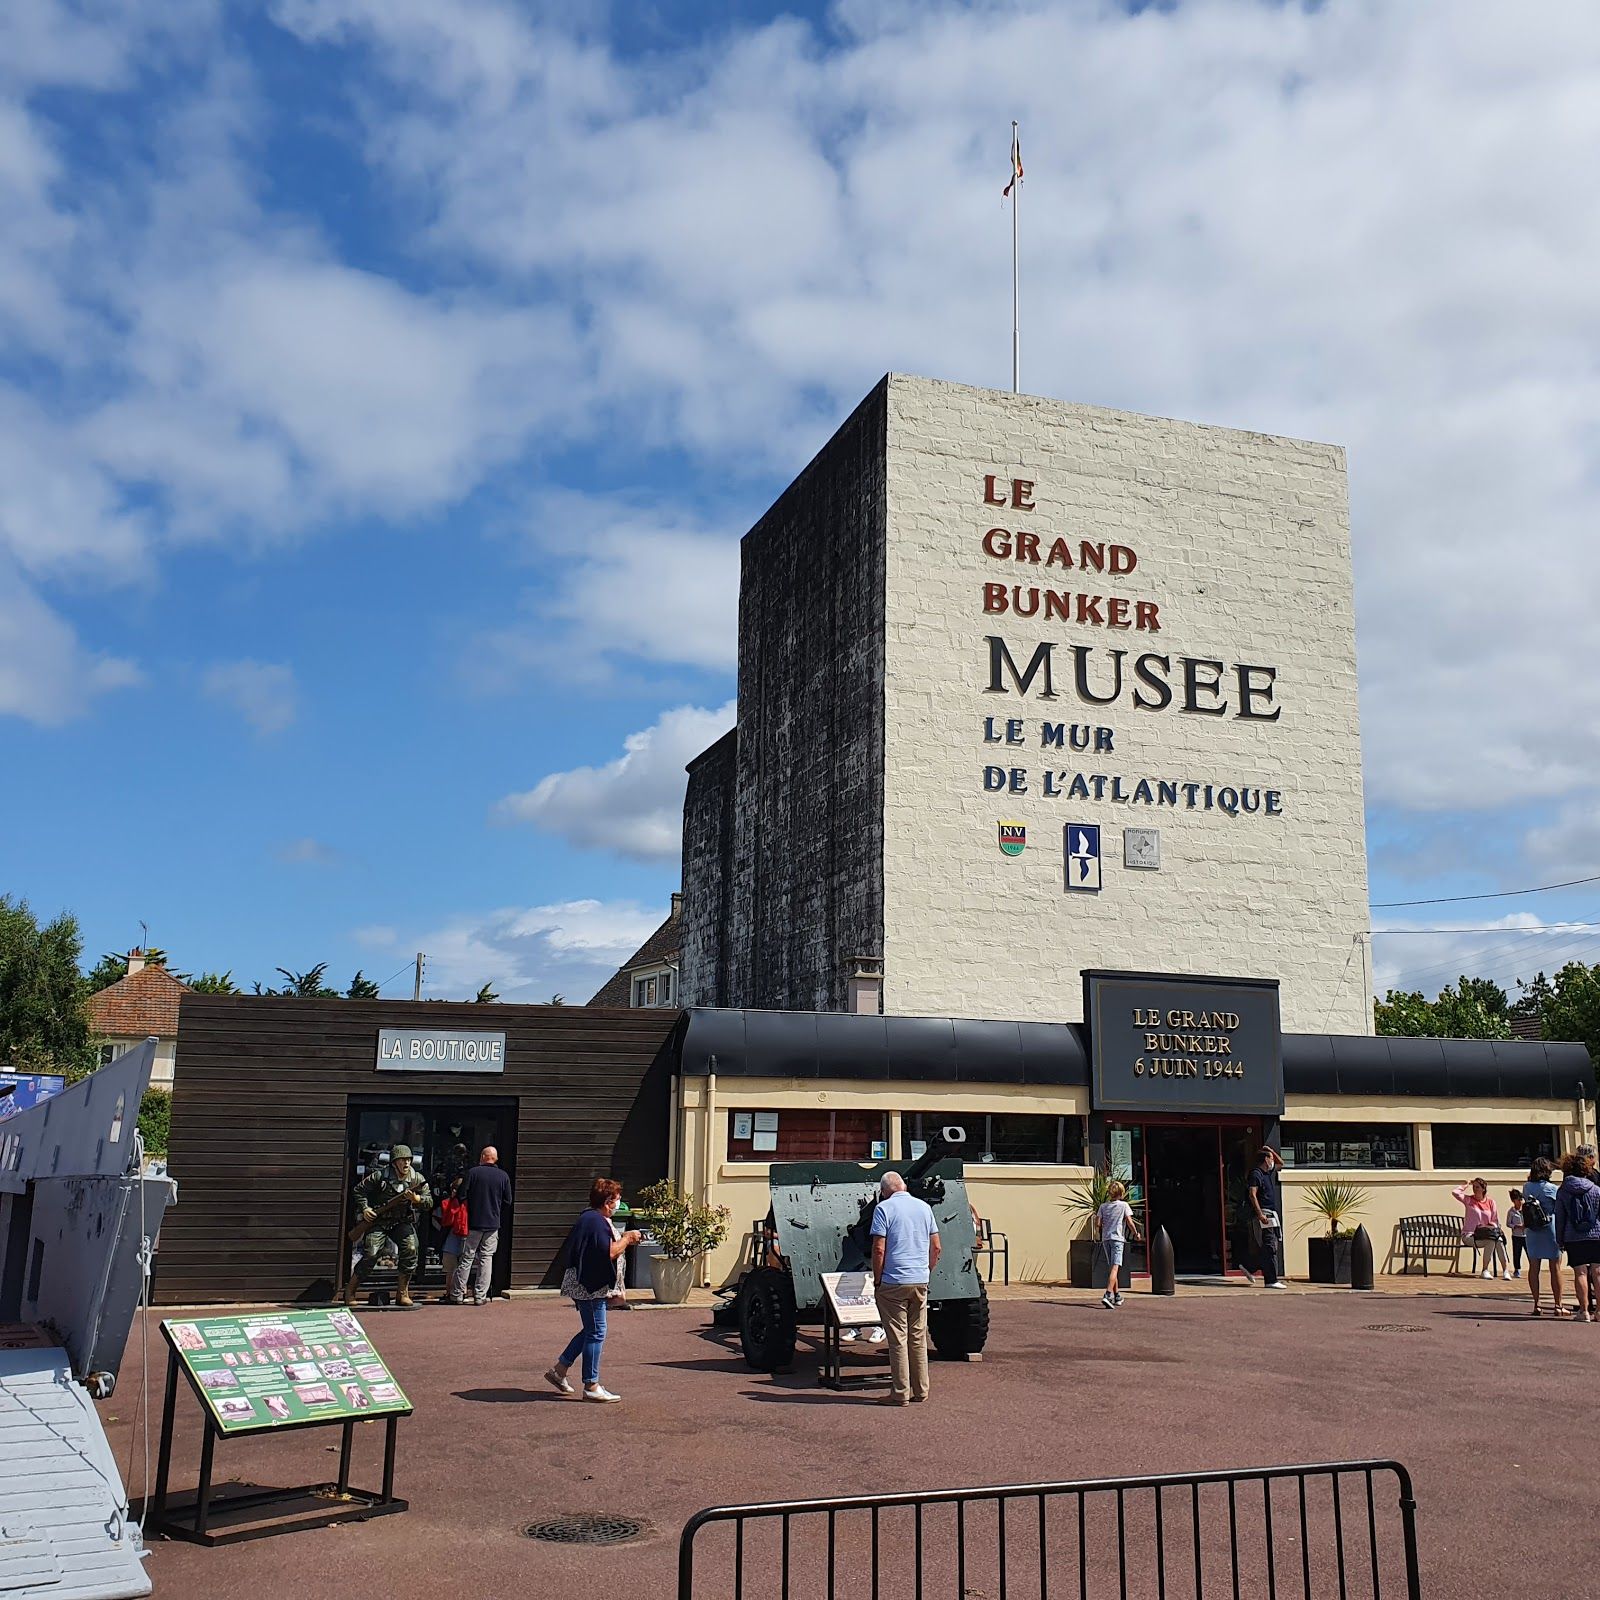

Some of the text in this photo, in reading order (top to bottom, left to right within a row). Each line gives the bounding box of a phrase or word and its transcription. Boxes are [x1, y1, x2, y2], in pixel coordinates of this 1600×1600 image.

[983, 475, 1036, 511] LE
[982, 528, 1138, 575] GRAND
[983, 582, 1161, 633] BUNKER
[983, 635, 1282, 722] MUSEE
[984, 717, 1114, 753] LE MUR
[984, 766, 1283, 817] DE L'ATLANTIQUE
[1133, 1008, 1240, 1032] LE GRAND
[381, 1038, 502, 1062] LA BOUTIQUE
[1144, 1033, 1232, 1054] BUNKER
[1134, 1057, 1244, 1079] 6 JUIN 1944
